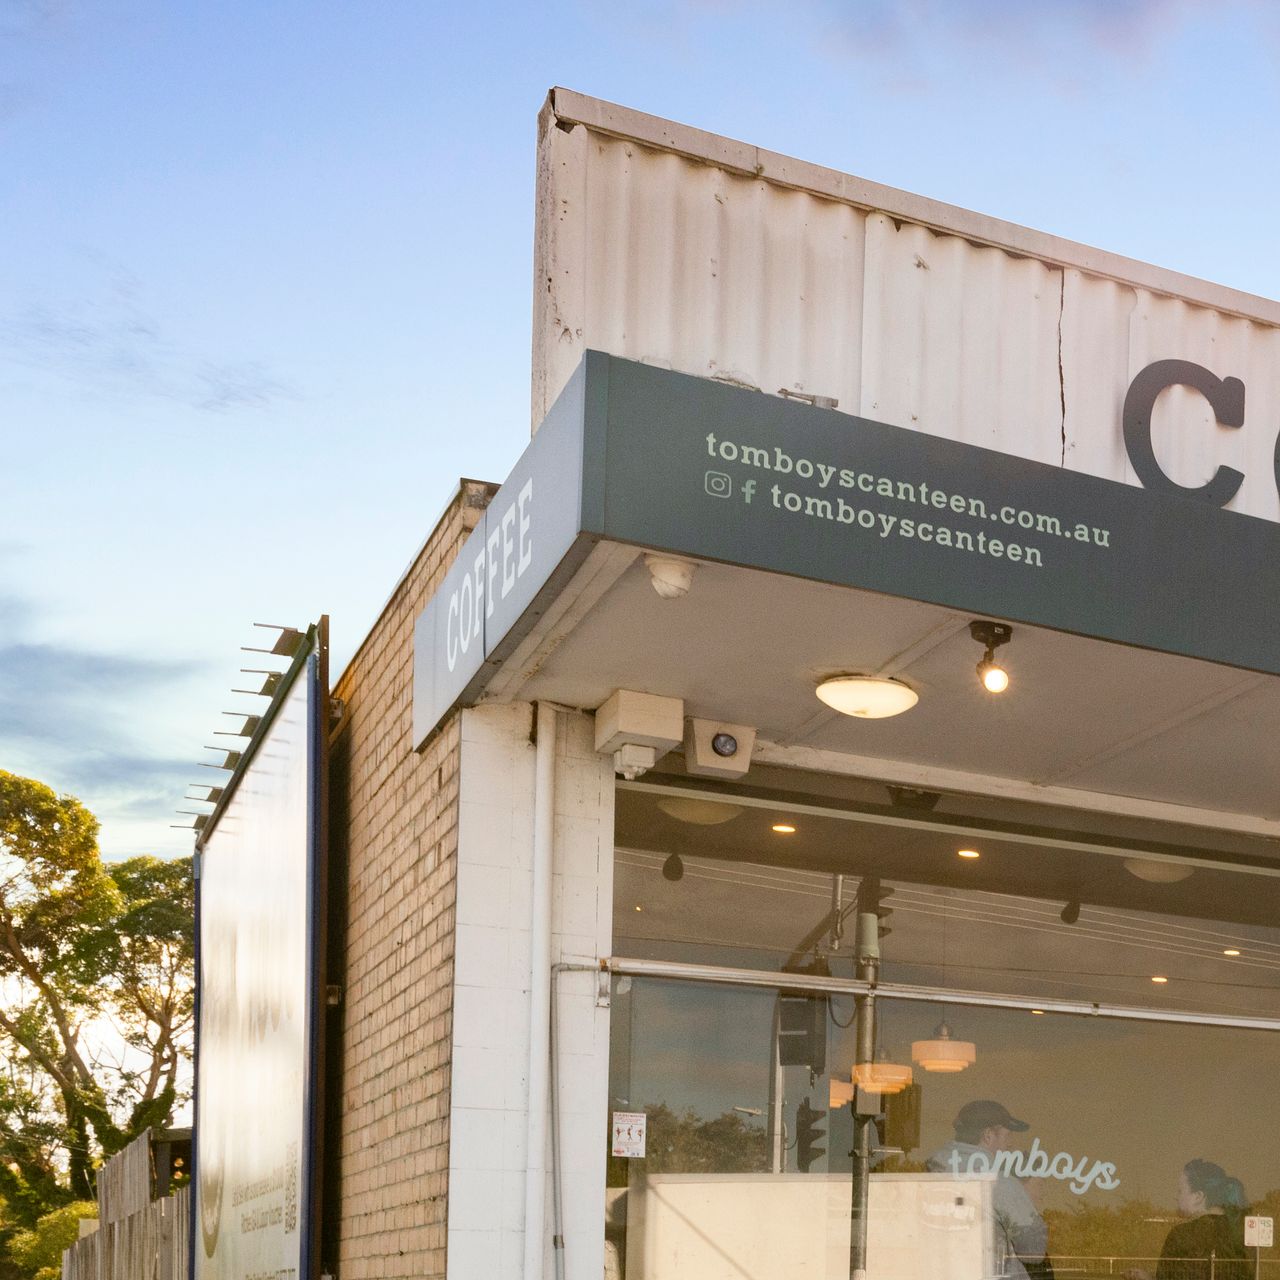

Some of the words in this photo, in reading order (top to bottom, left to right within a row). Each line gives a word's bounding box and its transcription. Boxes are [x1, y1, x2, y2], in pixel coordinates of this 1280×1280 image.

[705, 431, 1112, 548] tomboyscanteen.com.au
[769, 483, 1044, 567] tomboyscanteen
[447, 476, 533, 673] COFFEE
[948, 1137, 1120, 1195] tomboys
